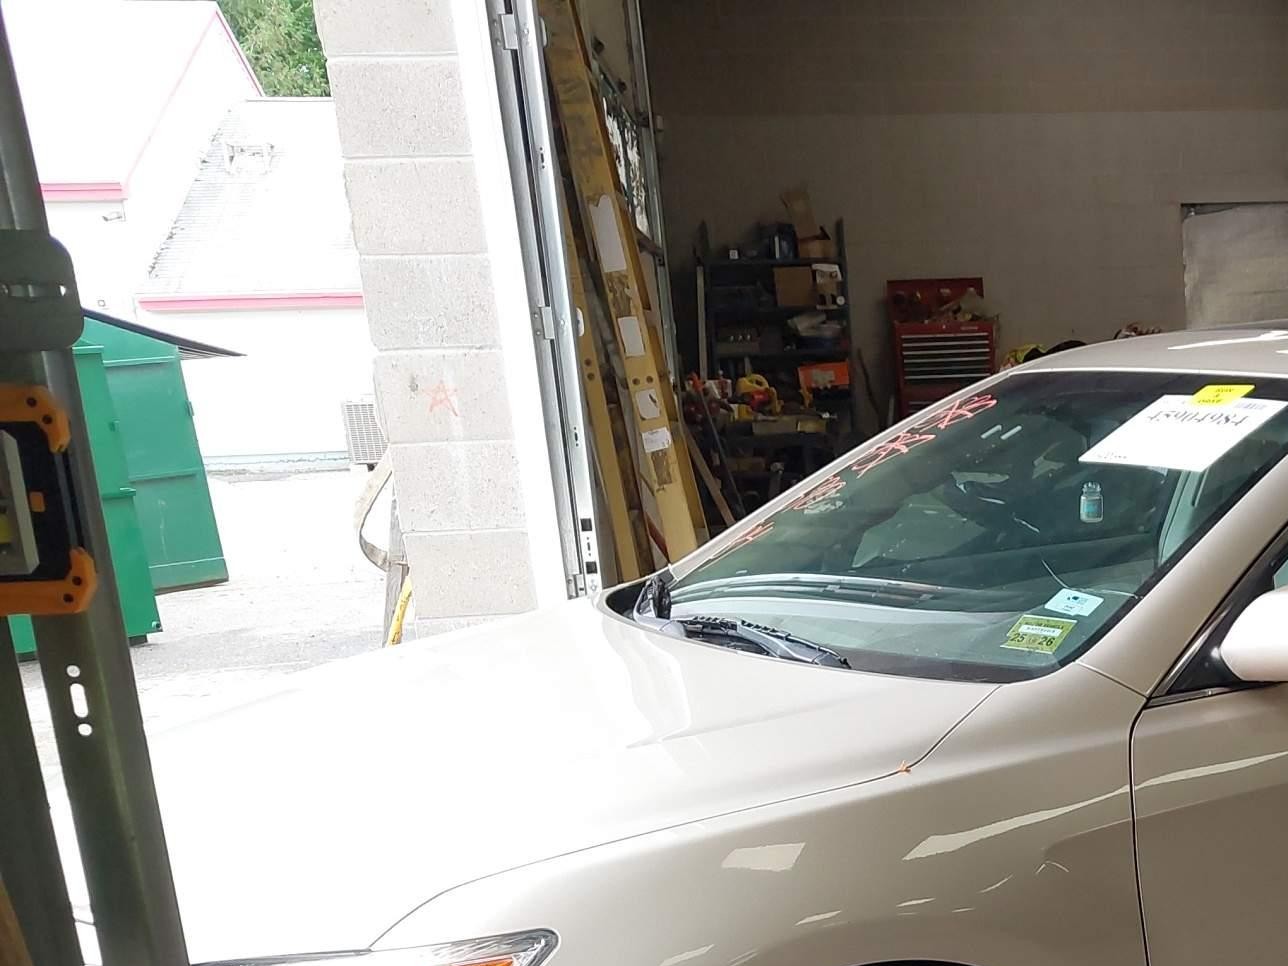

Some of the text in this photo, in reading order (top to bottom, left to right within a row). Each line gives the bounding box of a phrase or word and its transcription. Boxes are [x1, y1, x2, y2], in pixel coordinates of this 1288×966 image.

[1147, 410, 1249, 427] 45904984
[1010, 632, 1056, 647] 25 26
